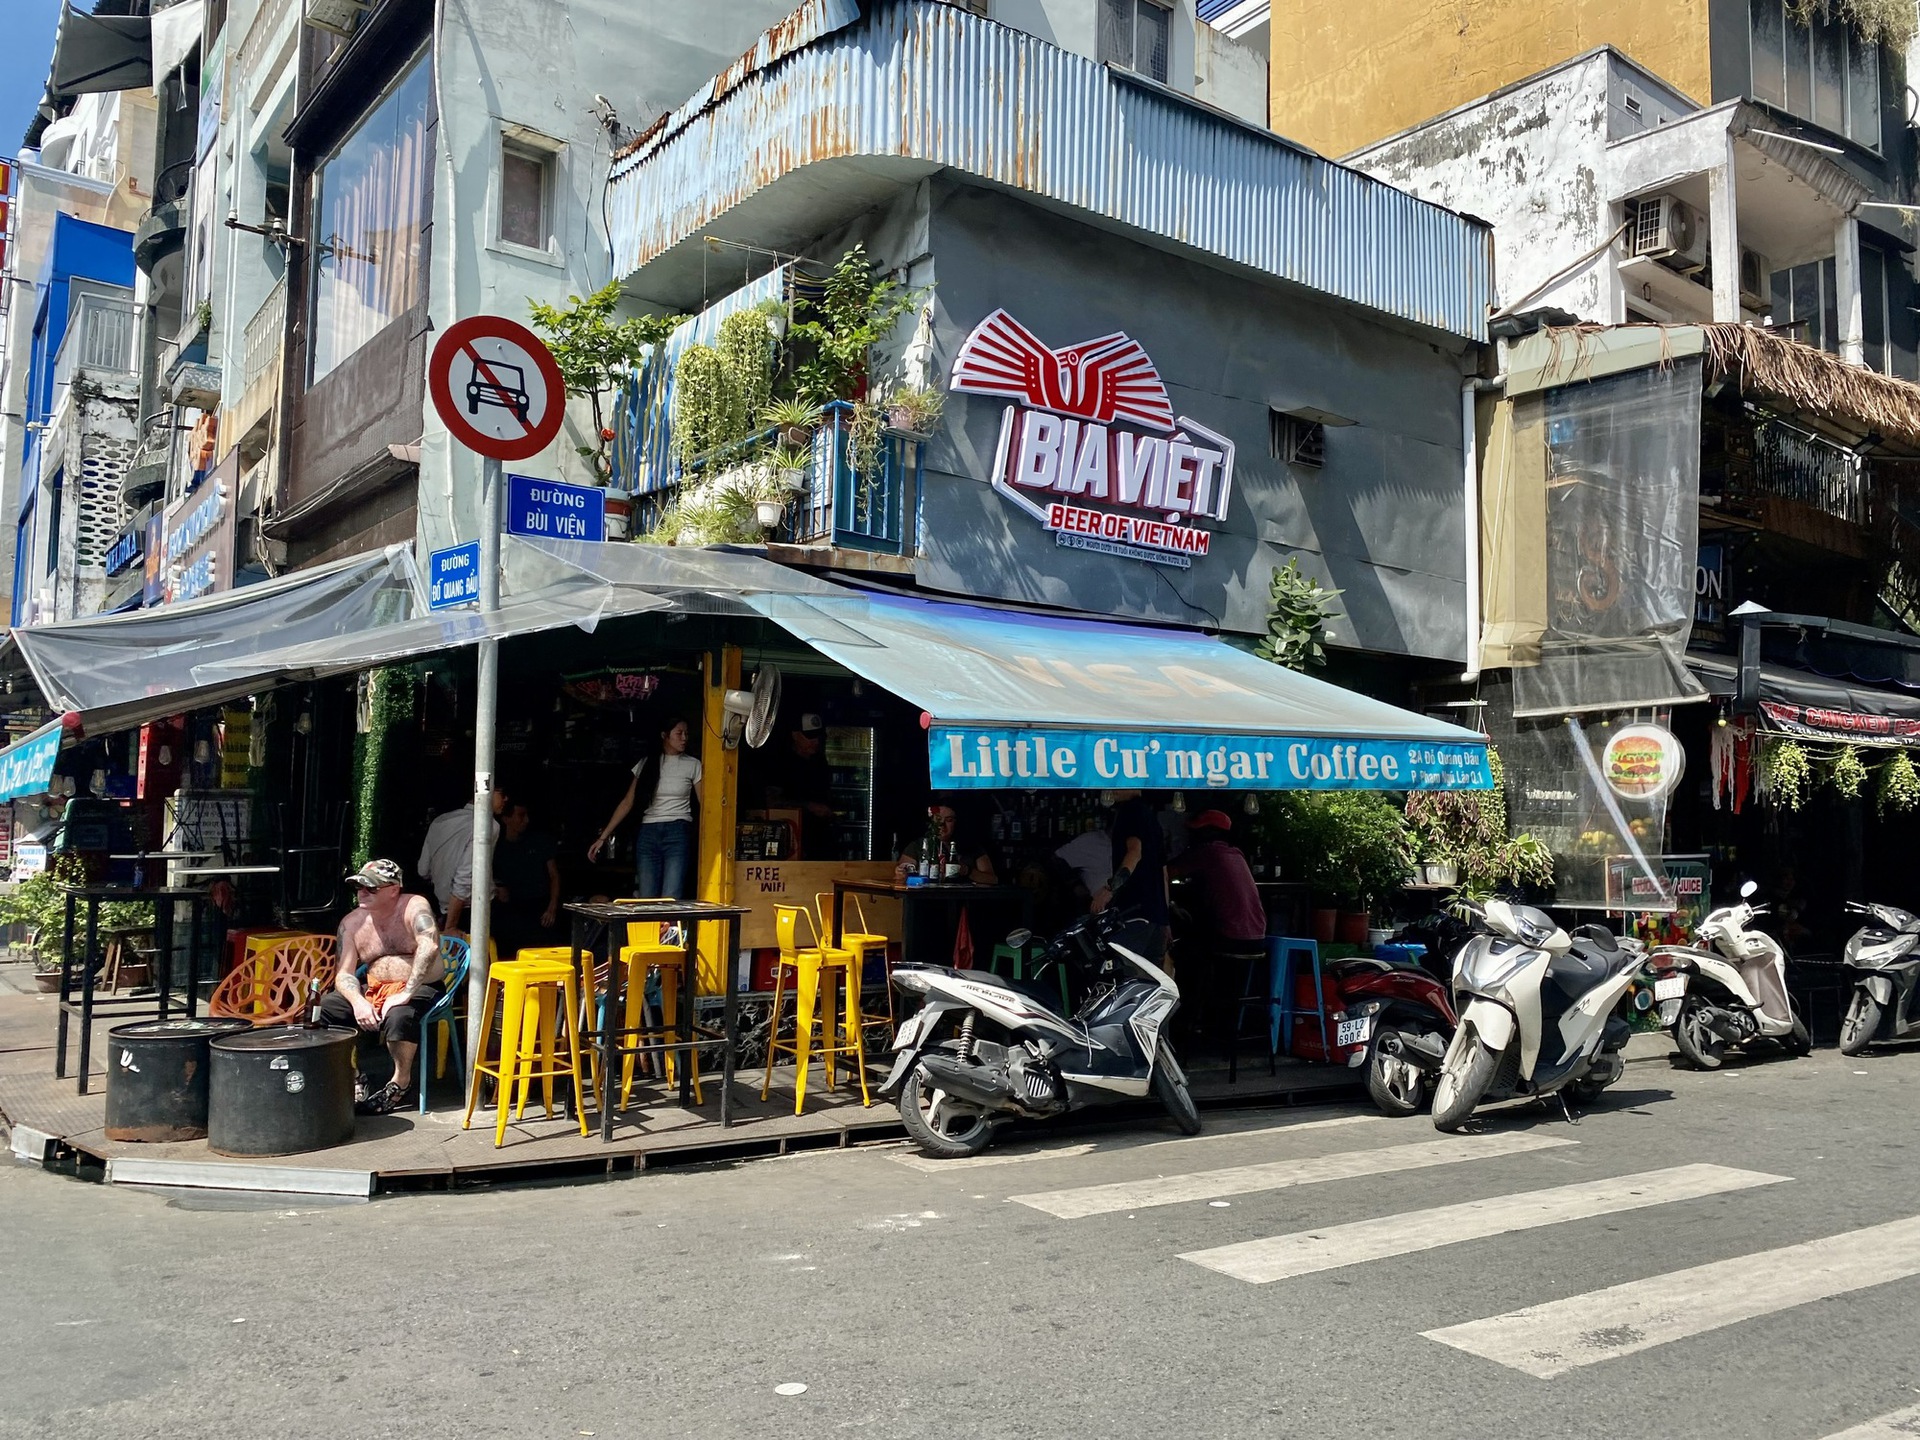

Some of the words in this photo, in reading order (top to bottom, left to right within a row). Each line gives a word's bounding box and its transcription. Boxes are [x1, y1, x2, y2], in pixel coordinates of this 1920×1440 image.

[1015, 411, 1109, 498] BIA
[1116, 432, 1224, 524] VIỆT
[530, 488, 585, 508] ĐƯỜNG
[526, 508, 548, 532] BÙI
[555, 514, 586, 539] VIỆN
[1050, 505, 1102, 535] BEER
[1104, 515, 1130, 539] OF
[1133, 520, 1210, 554] VIETNAM
[441, 553, 470, 572] ĐƯỜNG
[443, 577, 463, 599] QUANG
[1805, 707, 1890, 734] CHICKEN
[946, 734, 1078, 779] Little
[1287, 743, 1399, 781] Coffee
[746, 866, 780, 881] FREE
[1678, 879, 1702, 892] JUICE
